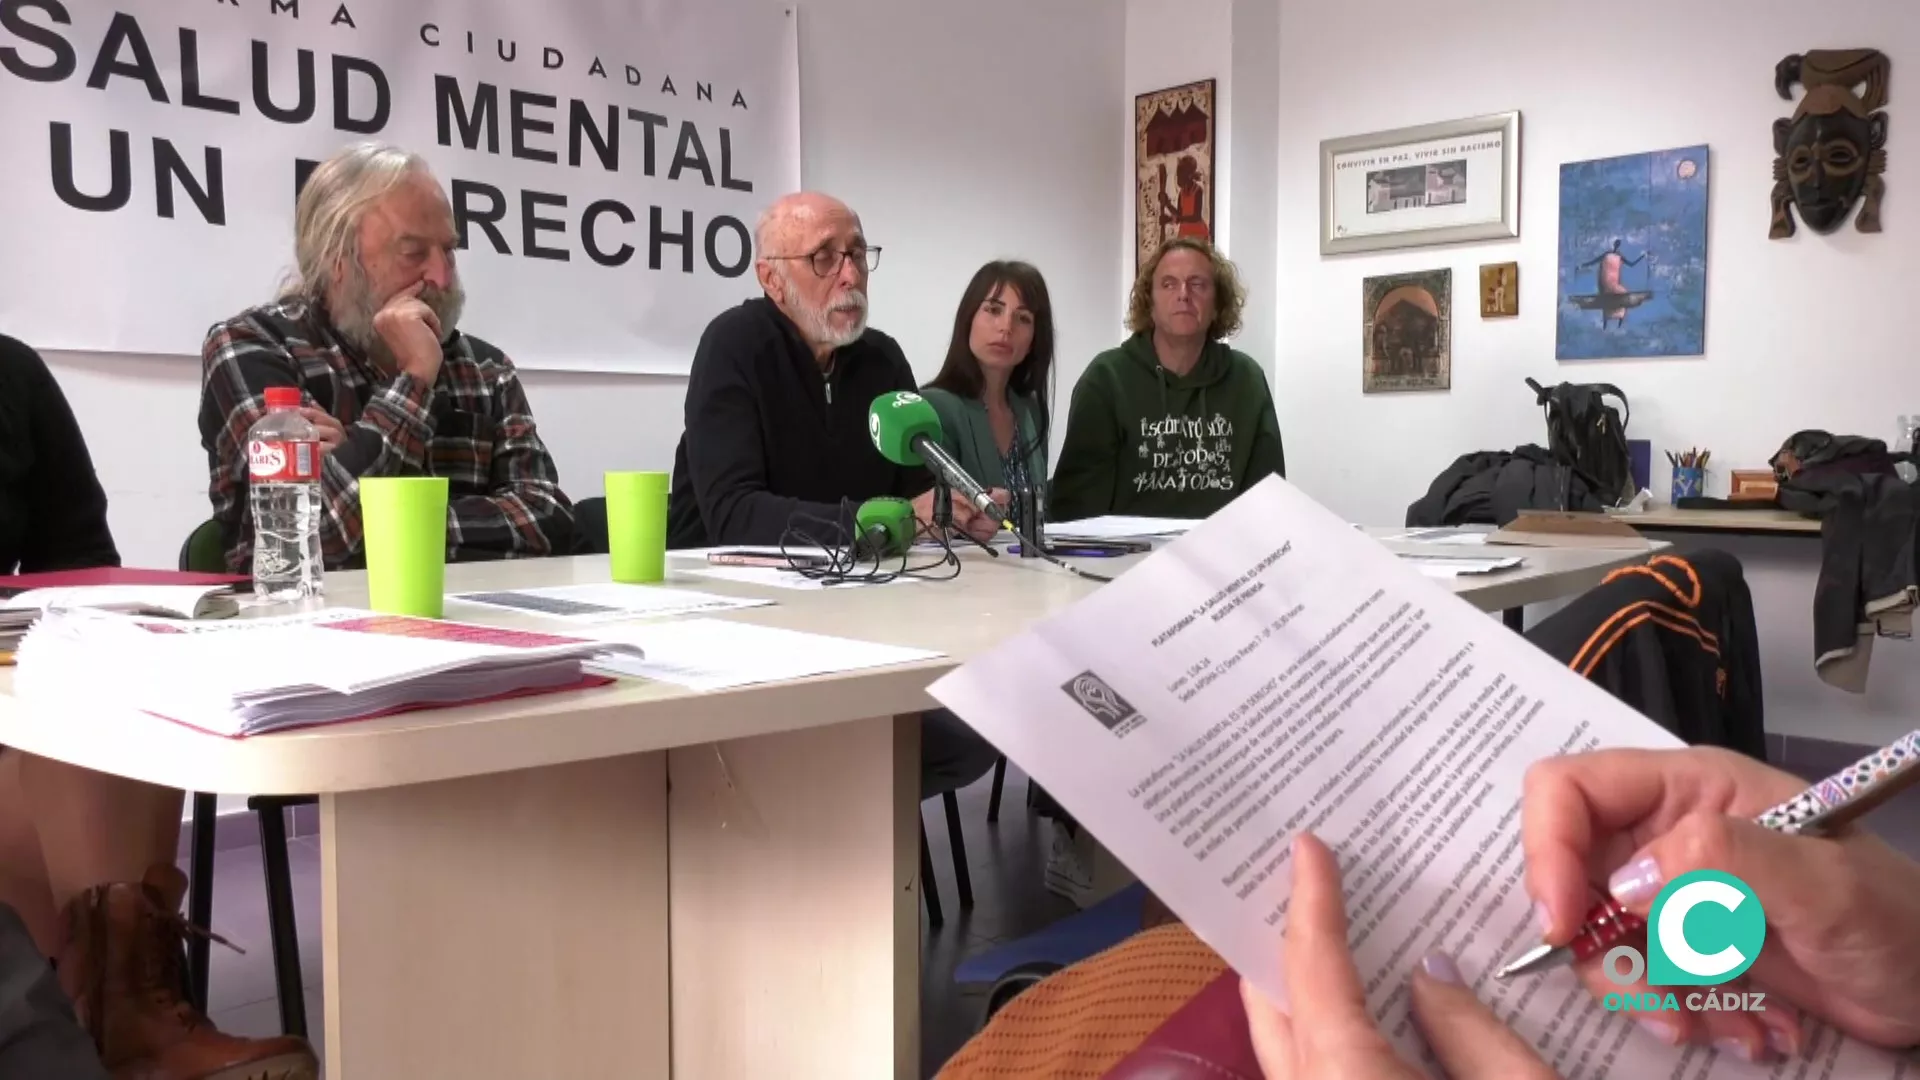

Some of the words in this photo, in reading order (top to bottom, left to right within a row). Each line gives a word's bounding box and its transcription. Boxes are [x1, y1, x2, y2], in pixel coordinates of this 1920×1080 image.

[0, 0, 391, 134] SALUD
[434, 73, 754, 192] MENTAL
[420, 23, 748, 110] CIUDADANA
[1336, 158, 1376, 170] CONVIVIR
[1378, 155, 1390, 164] EN
[1414, 148, 1439, 159] VIVIR
[1441, 146, 1458, 156] SIN
[1460, 141, 1502, 153] RACISMO
[49, 121, 226, 226] UN
[295, 159, 752, 278] RECHO
[1260, 694, 1285, 716] Mental
[1138, 762, 1176, 793] plataforma
[1202, 719, 1233, 742] MENTAL
